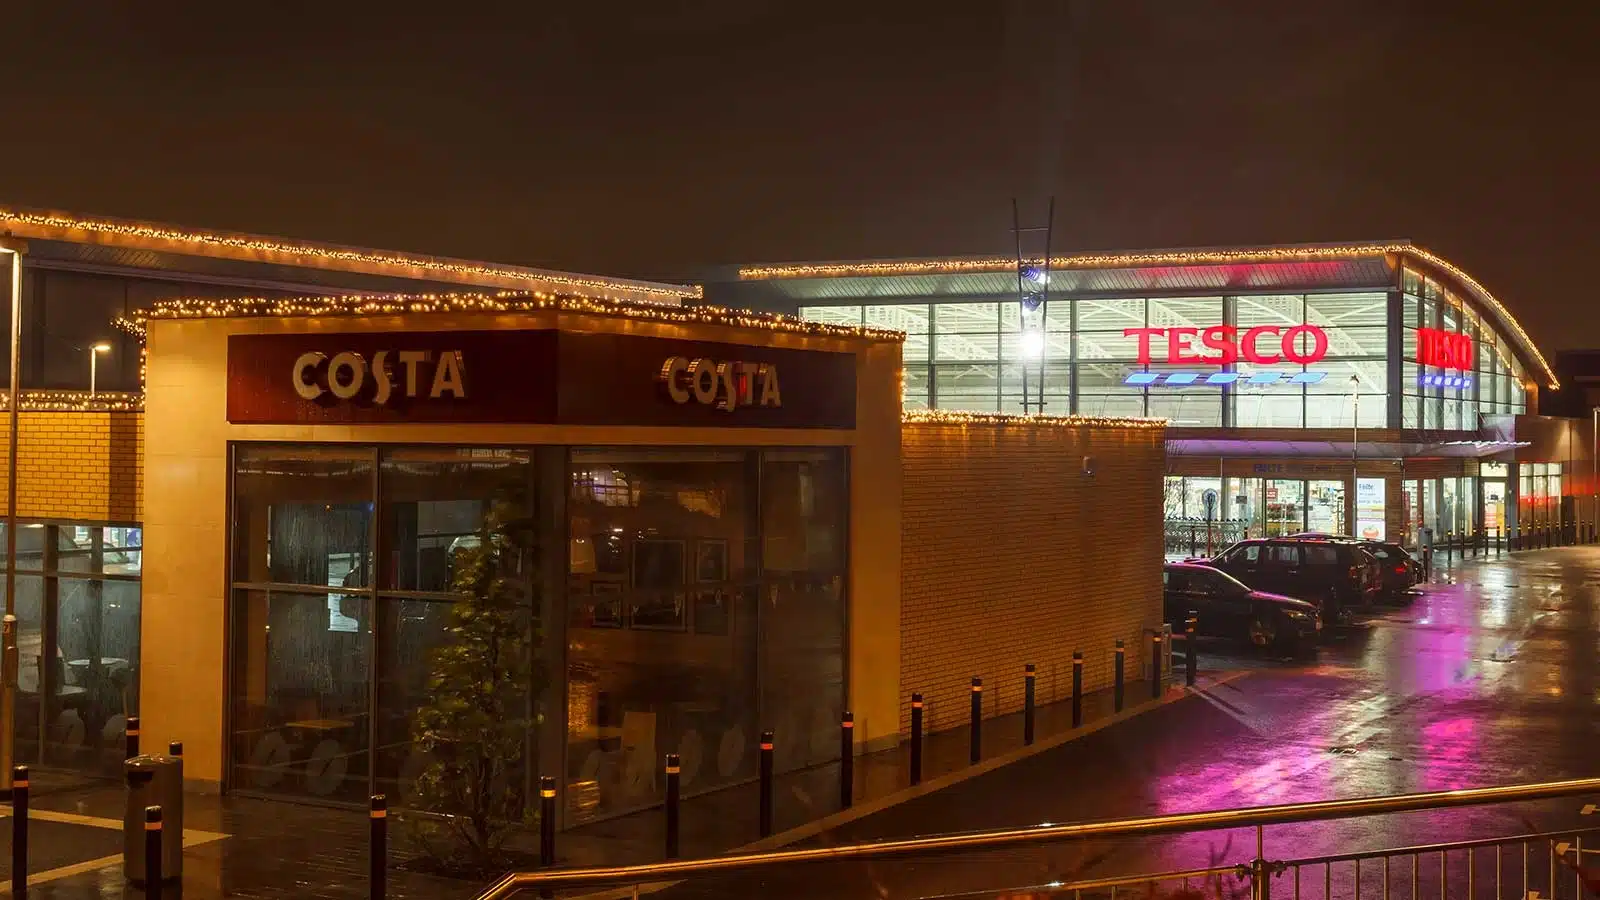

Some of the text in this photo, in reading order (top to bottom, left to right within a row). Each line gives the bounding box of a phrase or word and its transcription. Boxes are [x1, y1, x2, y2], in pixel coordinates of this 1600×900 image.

[1124, 325, 1328, 364] TESCO
[1416, 328, 1472, 371] TESCO
[293, 351, 465, 404] COSTA
[667, 357, 781, 412] COSTA
